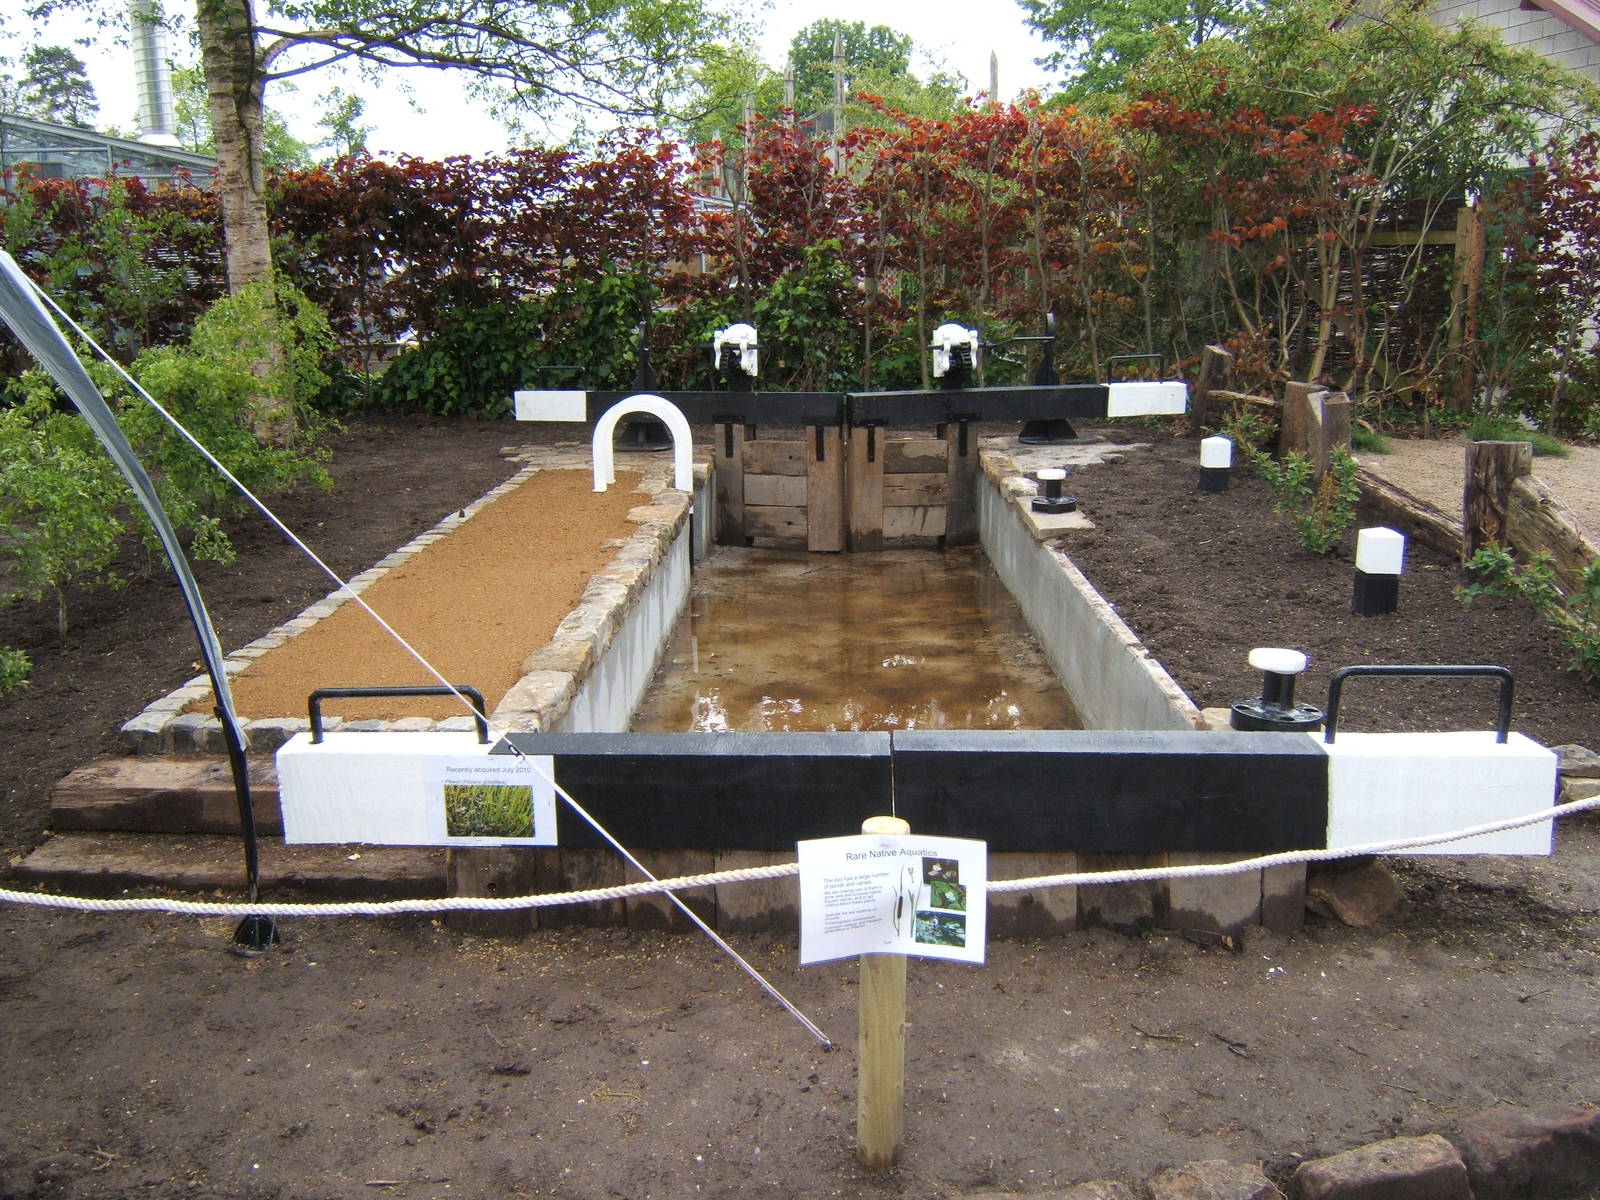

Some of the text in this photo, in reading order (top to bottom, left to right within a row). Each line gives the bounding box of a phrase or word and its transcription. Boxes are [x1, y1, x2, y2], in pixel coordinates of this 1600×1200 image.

[446, 766, 473, 774] Recently
[502, 766, 514, 775] July
[515, 766, 531, 774] 2010
[846, 848, 938, 861] Rare Native Aquatics
